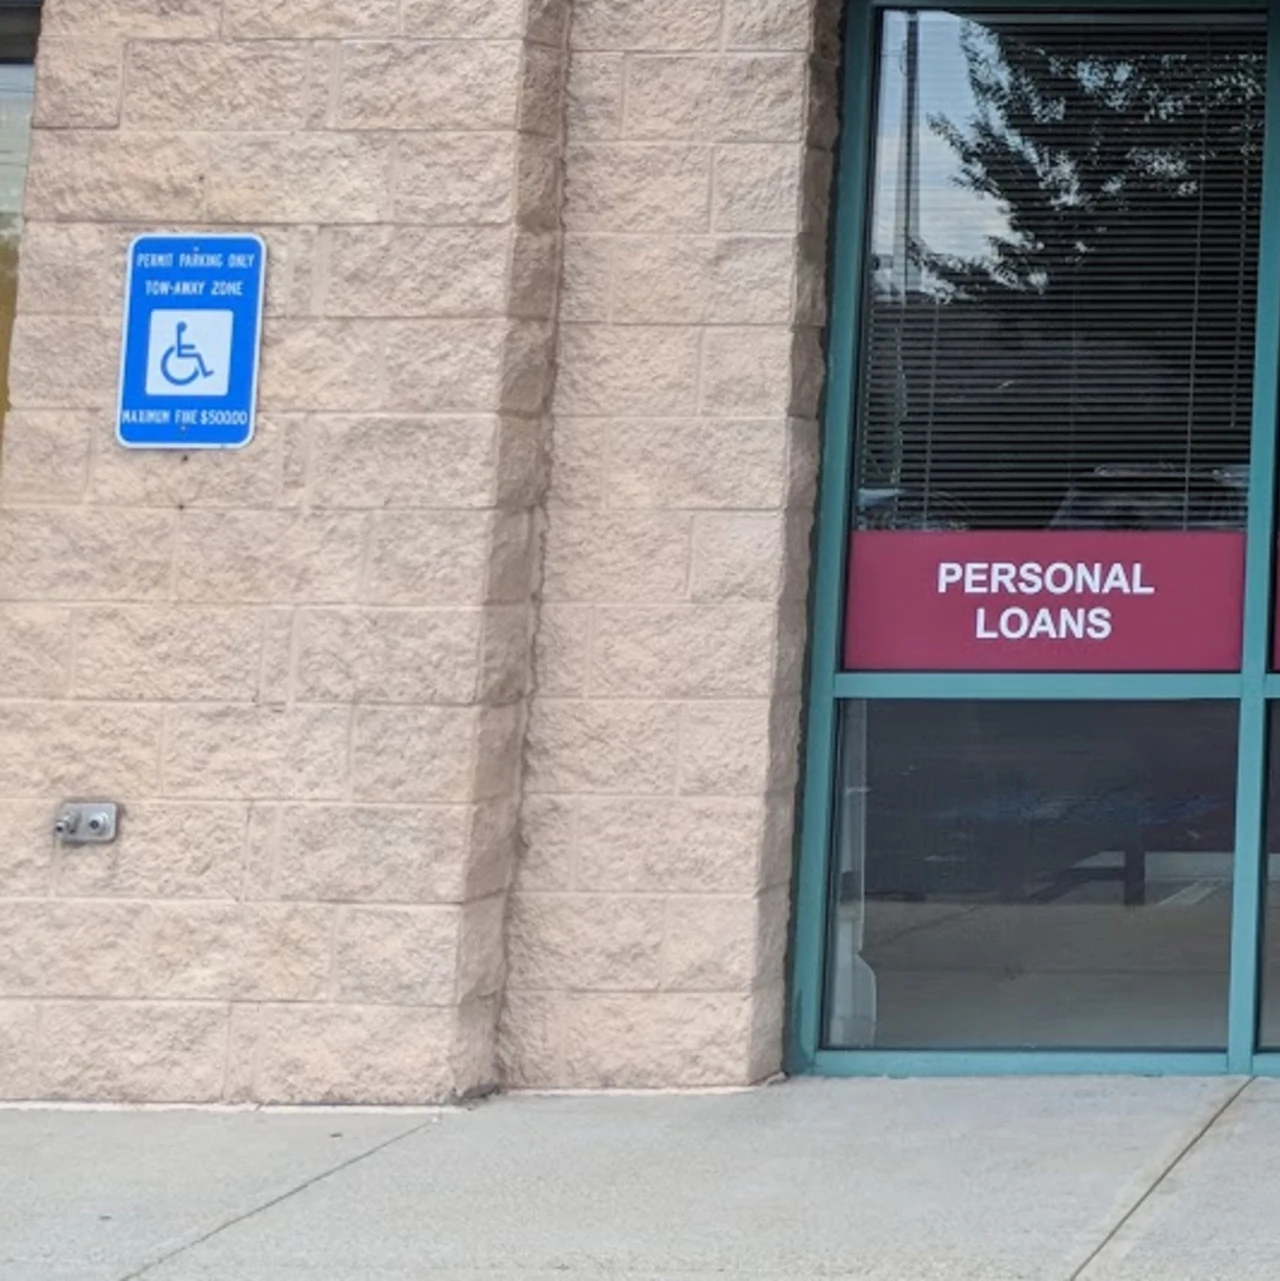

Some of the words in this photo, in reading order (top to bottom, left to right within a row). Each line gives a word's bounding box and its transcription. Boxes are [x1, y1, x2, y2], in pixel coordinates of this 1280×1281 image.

[136, 253, 174, 267] PERMIT
[179, 253, 223, 267] PARKING
[227, 253, 255, 268] ONLY
[145, 280, 206, 296] TOW-AWAY
[210, 280, 243, 296] ZONE
[122, 408, 171, 423] MAXIMUM
[174, 409, 198, 424] FINE
[937, 561, 1156, 595] PERSONAL
[975, 606, 1113, 640] LOANS
